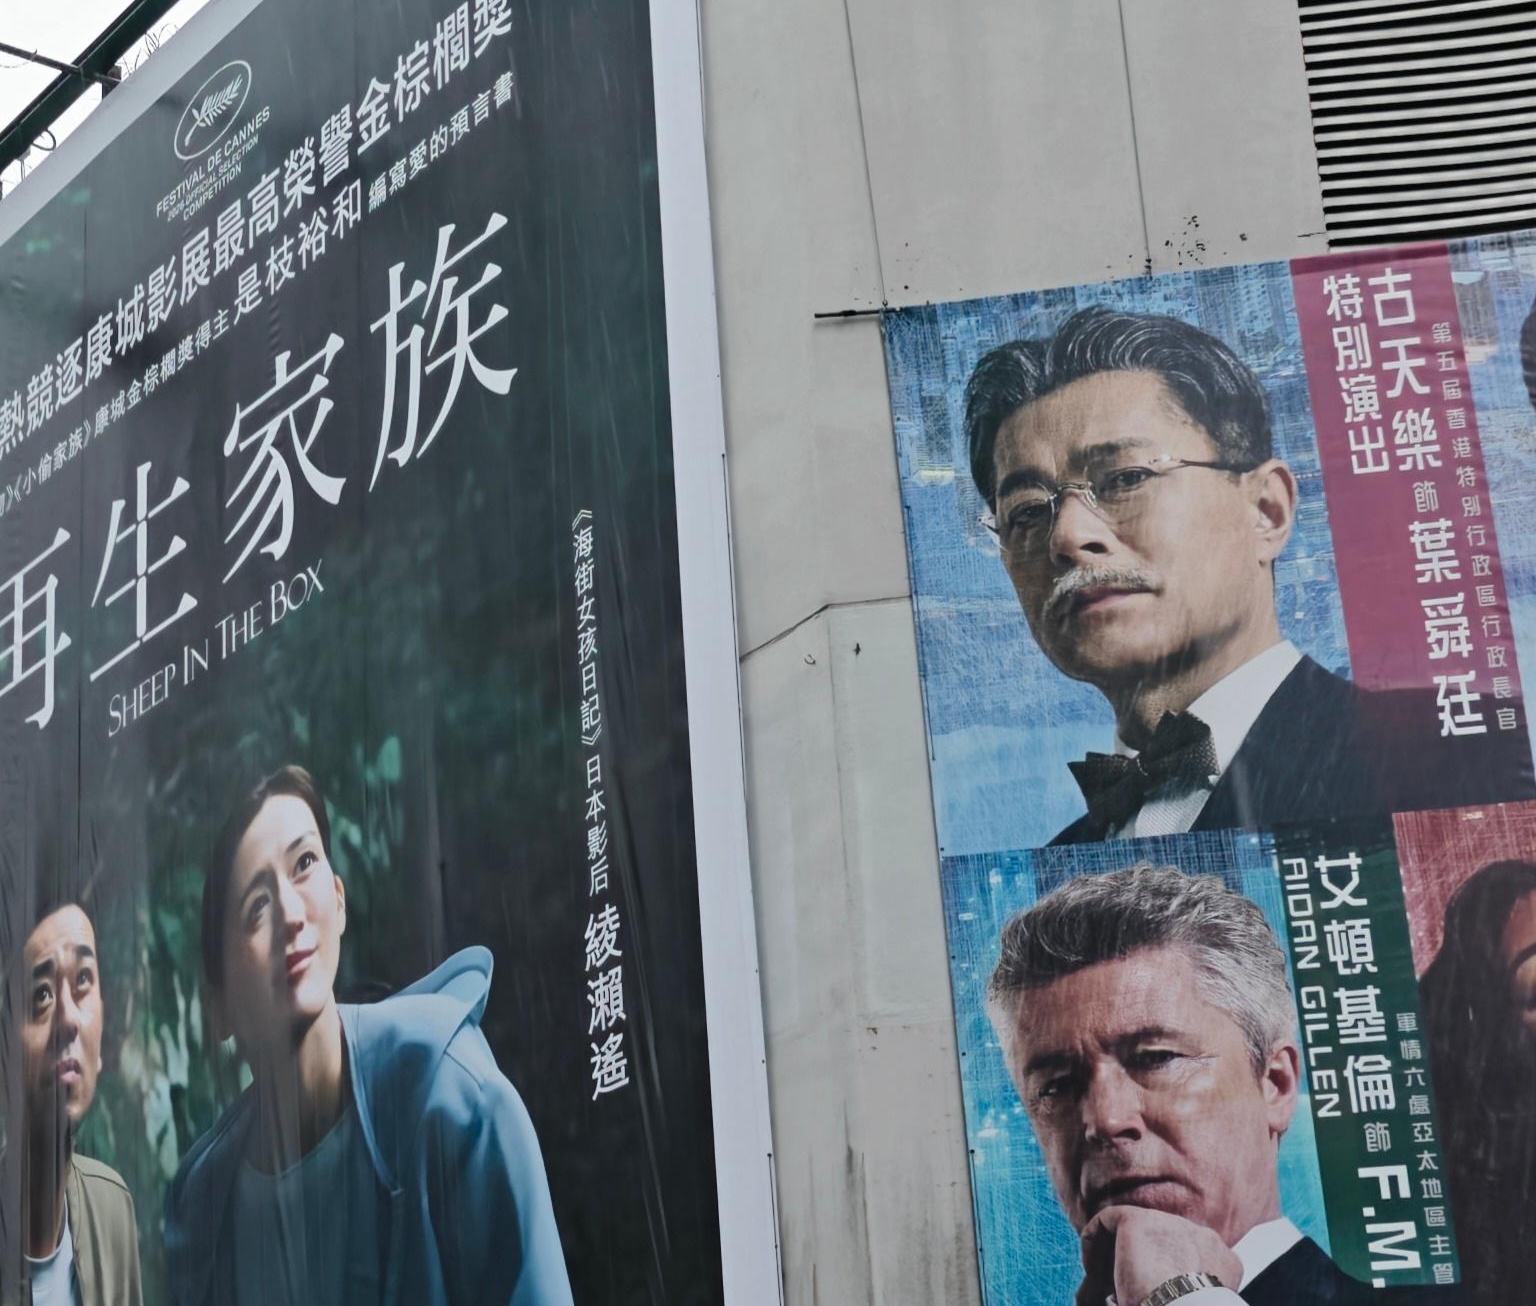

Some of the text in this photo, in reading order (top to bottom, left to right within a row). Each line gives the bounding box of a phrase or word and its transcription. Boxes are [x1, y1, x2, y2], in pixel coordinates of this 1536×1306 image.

[156, 106, 270, 218] FESTIVAL DE CANNES
[183, 162, 242, 221] COMPETITION
[185, 172, 217, 206] OFFICIAL
[218, 133, 259, 174] SELECTION
[1322, 273, 1390, 477] 特別演出
[108, 558, 324, 737] SHEEP IN THE BOX
[1282, 856, 1343, 1119] AIDAN GILLEN
[1396, 1012, 1456, 1284] 軍情六處亞太地區主管
